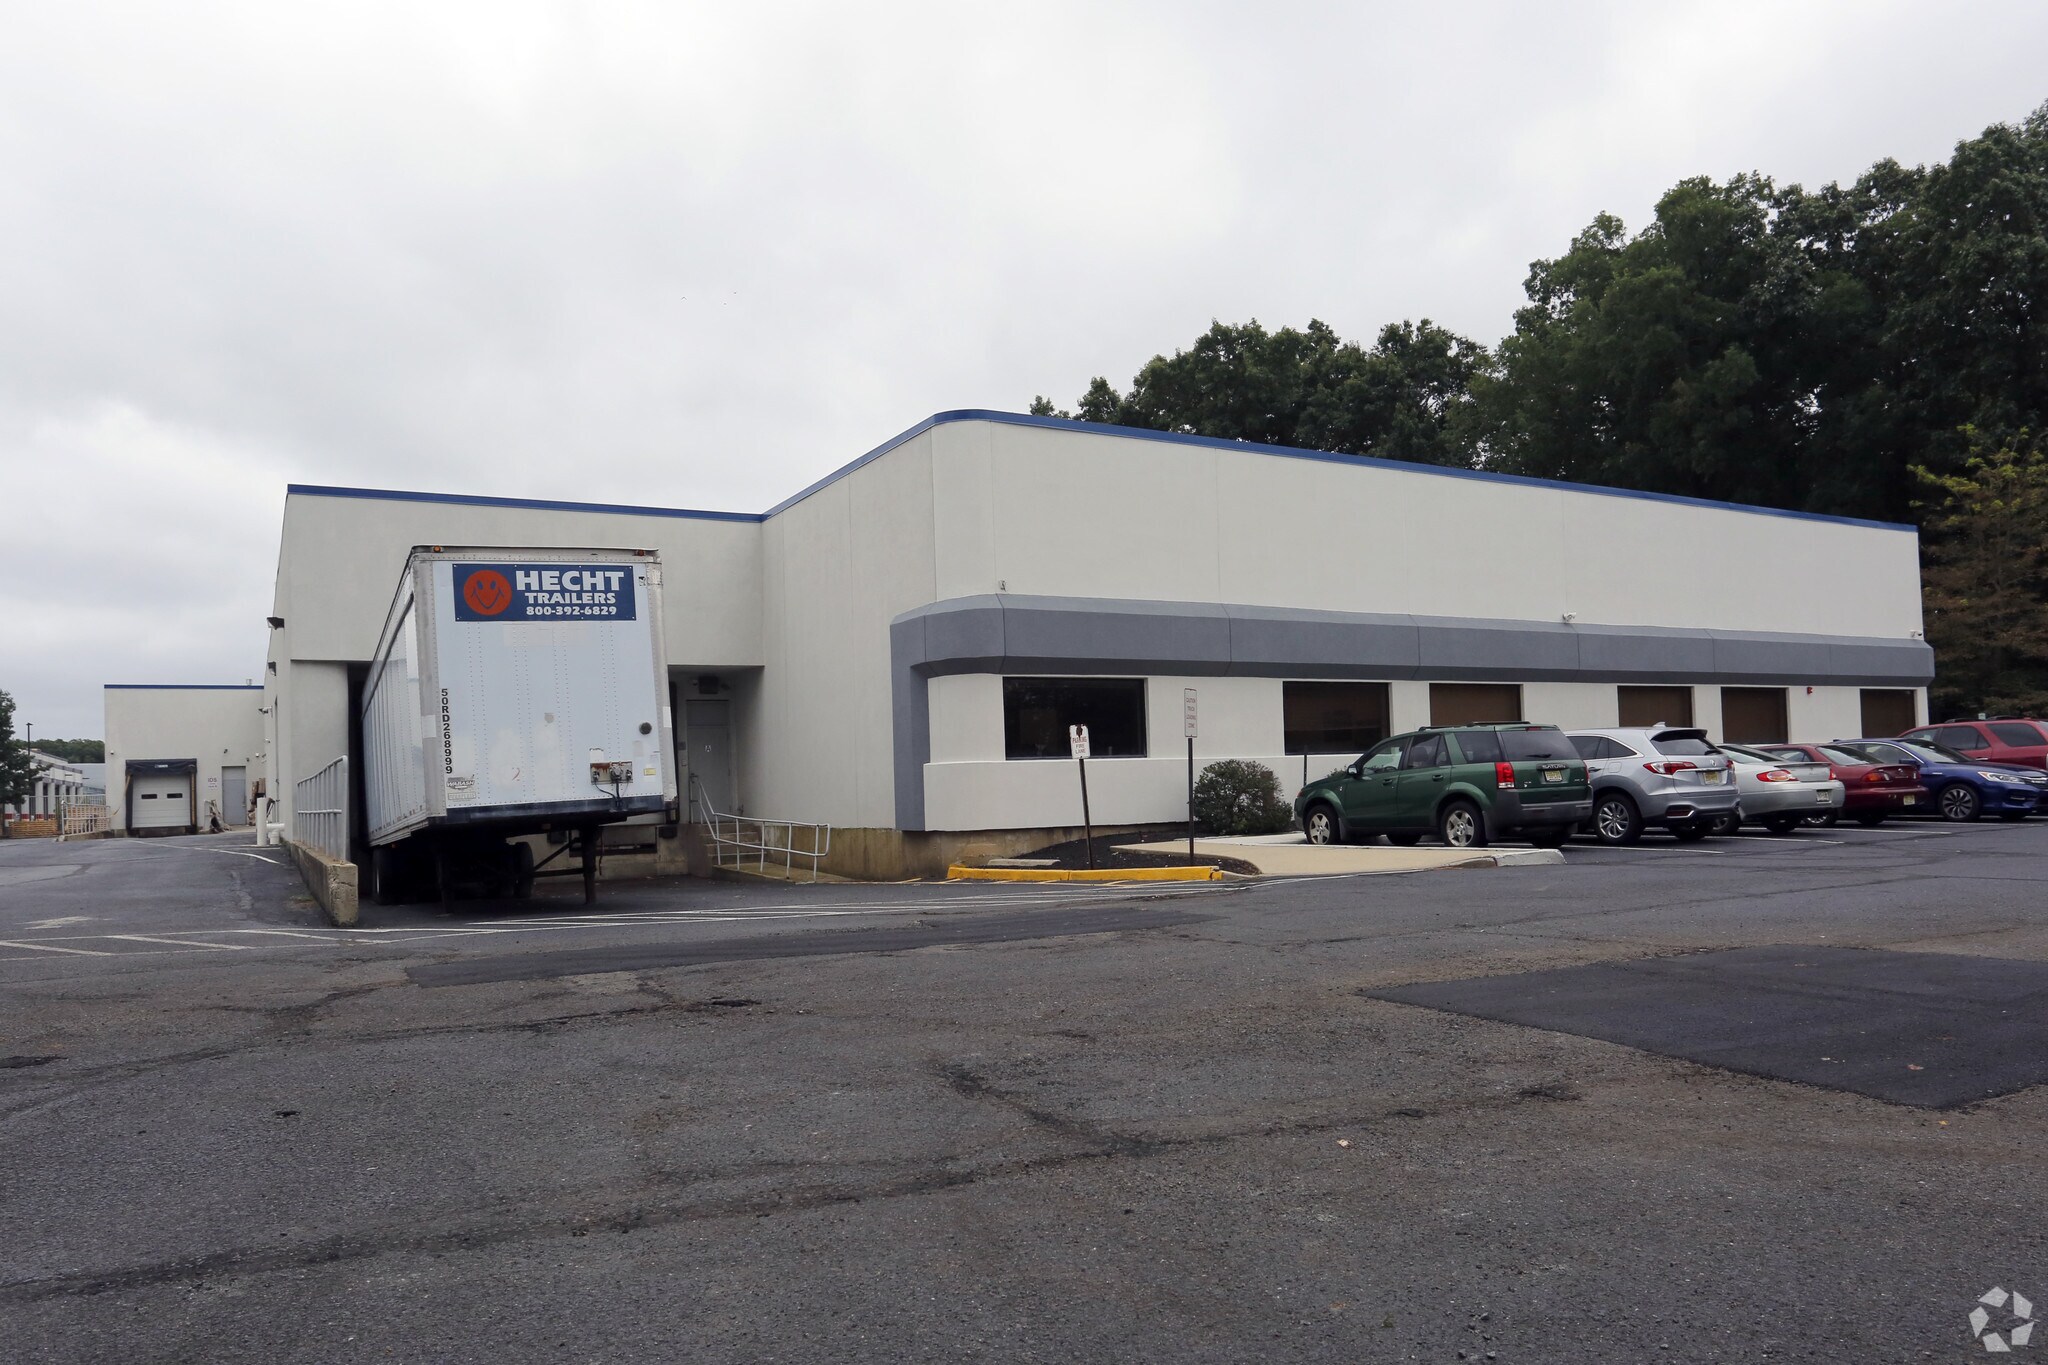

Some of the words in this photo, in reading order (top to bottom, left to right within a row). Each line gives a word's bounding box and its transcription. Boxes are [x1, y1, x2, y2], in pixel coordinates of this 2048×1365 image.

[515, 570, 625, 591] HECHT
[525, 592, 616, 604] TRAILERS
[526, 606, 617, 616] 800-392-6829
[441, 688, 453, 774] 50RD268999
